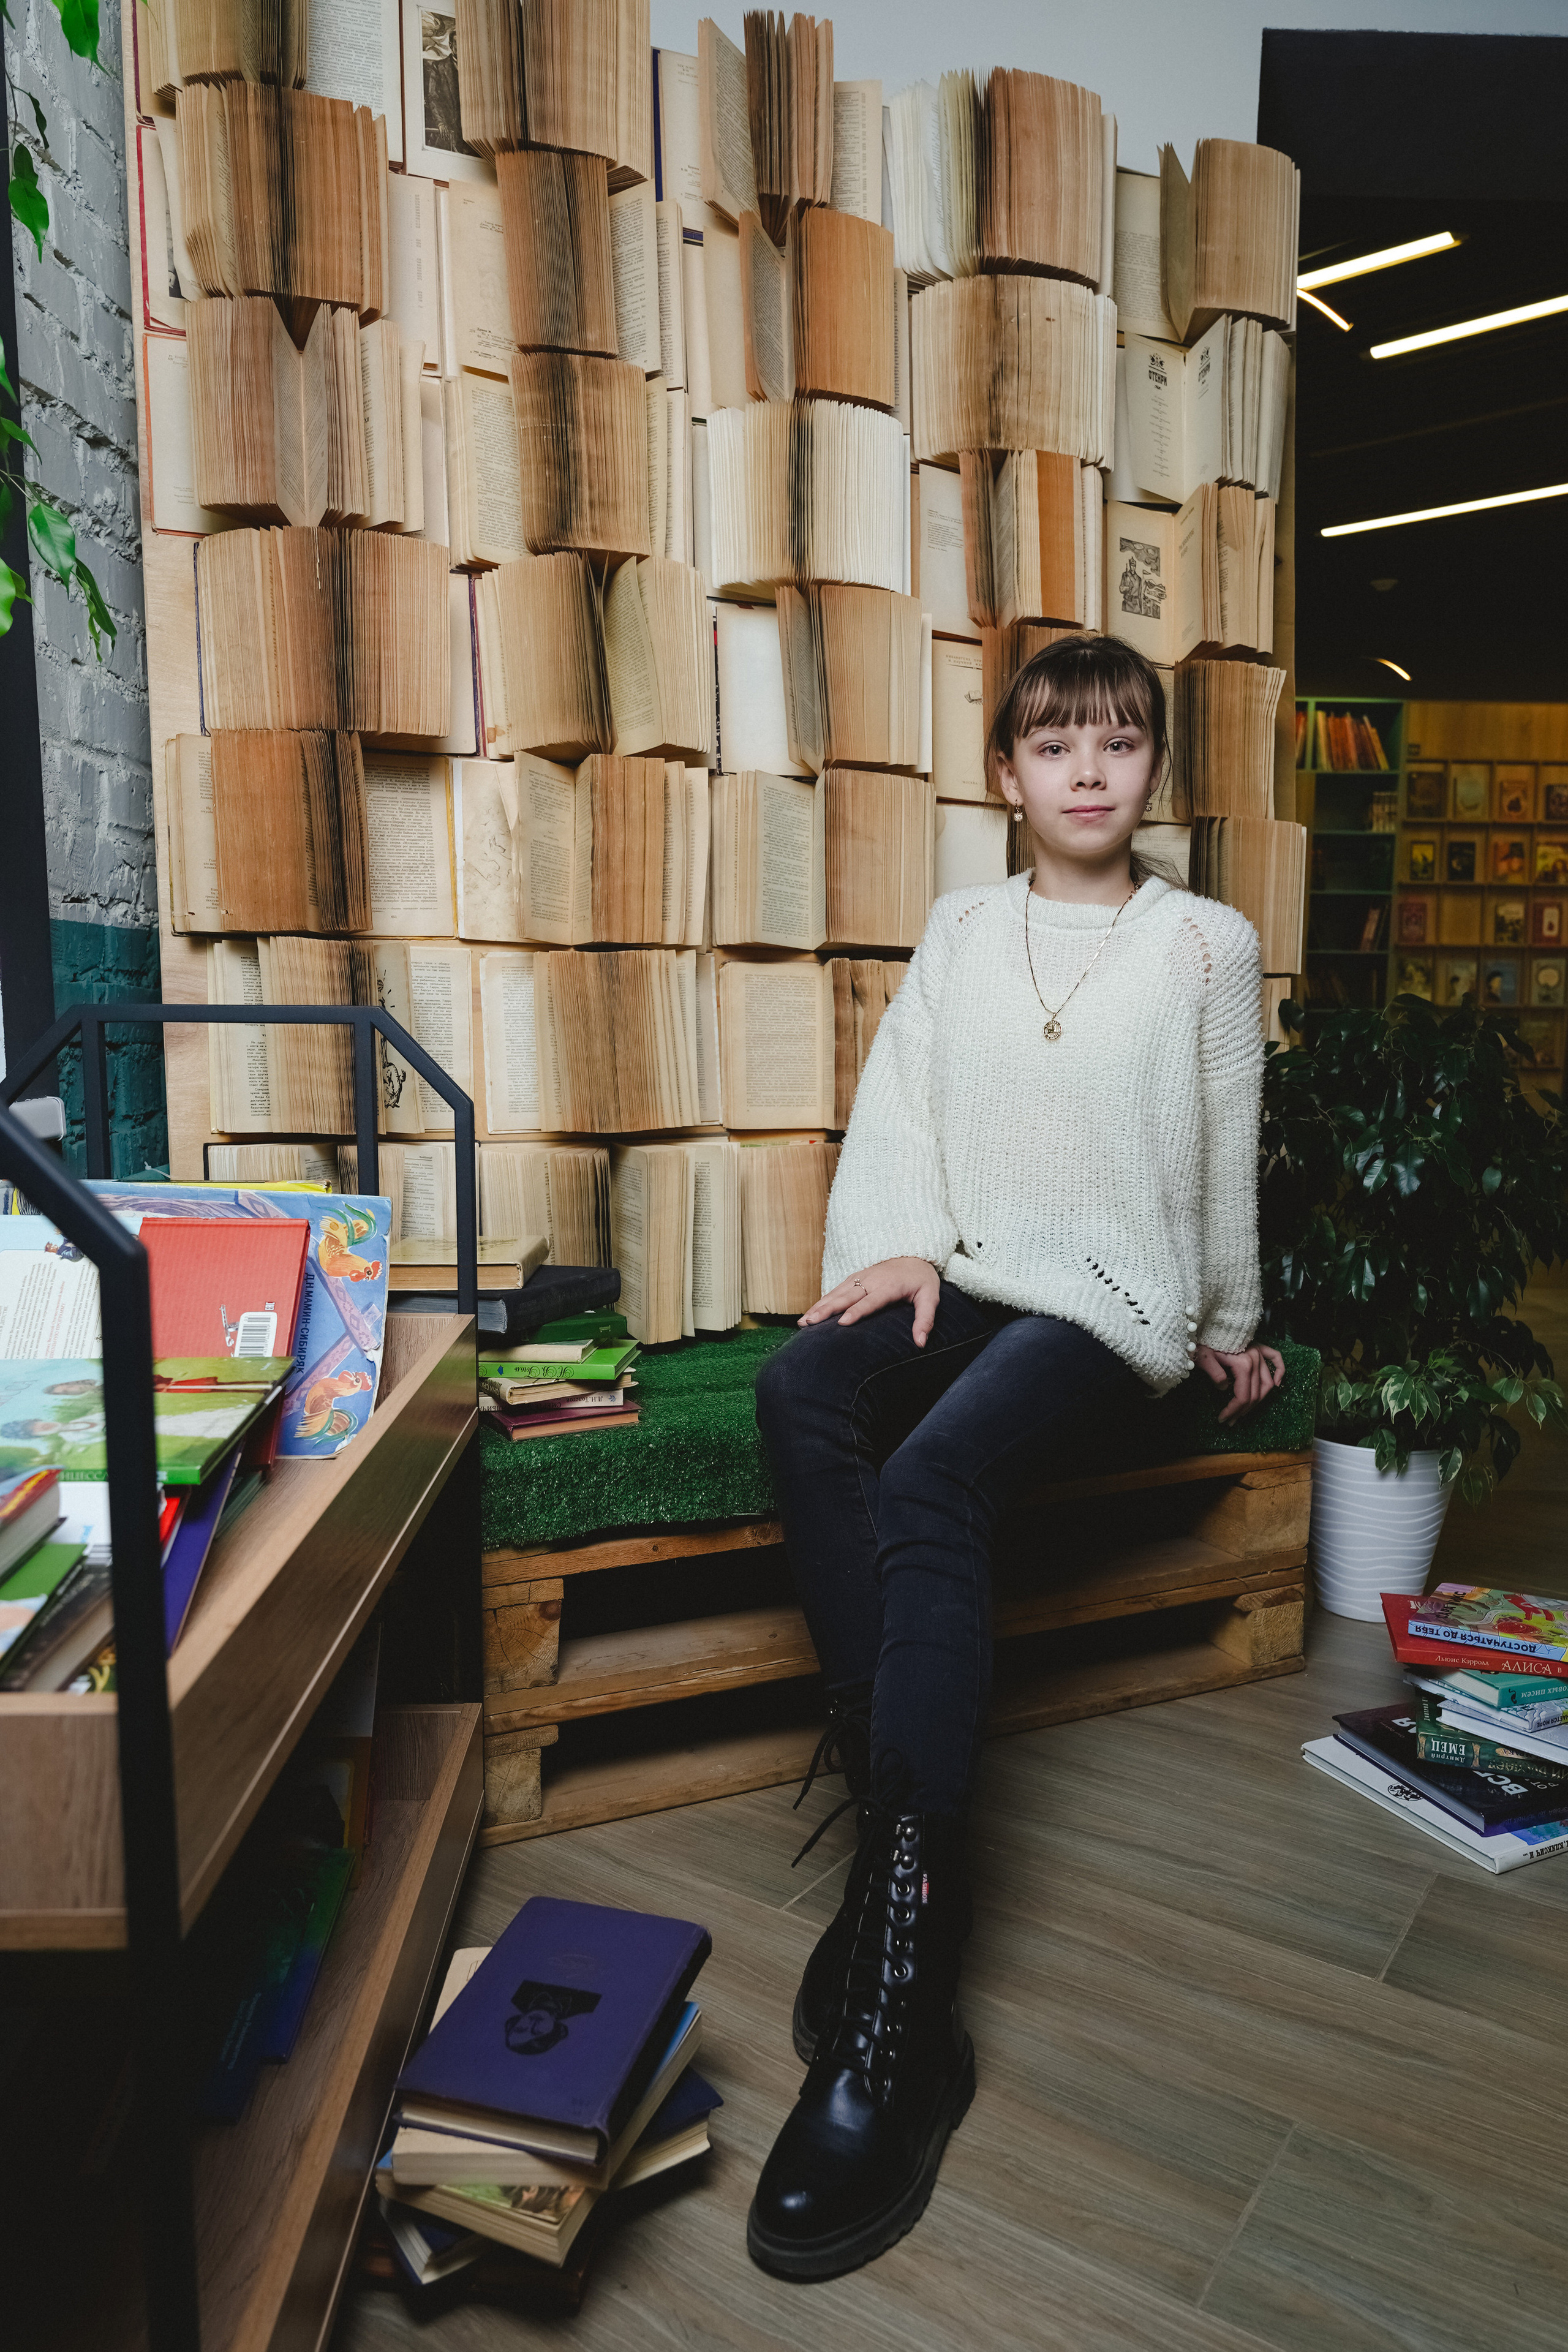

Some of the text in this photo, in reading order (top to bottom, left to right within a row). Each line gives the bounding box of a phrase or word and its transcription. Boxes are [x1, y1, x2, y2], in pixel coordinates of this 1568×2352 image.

[1415, 1625, 1537, 1653] ДОСТУЧАТЬСЯ ДО ТЕБЯ
[1461, 1658, 1490, 1667] Кэрролл
[1501, 1660, 1553, 1675] АЛИСА
[1536, 1719, 1550, 1728] МОРЕ
[1431, 1738, 1466, 1755] ЕМЕЦ
[1430, 1753, 1466, 1763] Дмитрий
[1536, 1842, 1564, 1857] КЛЯКСИЧ
